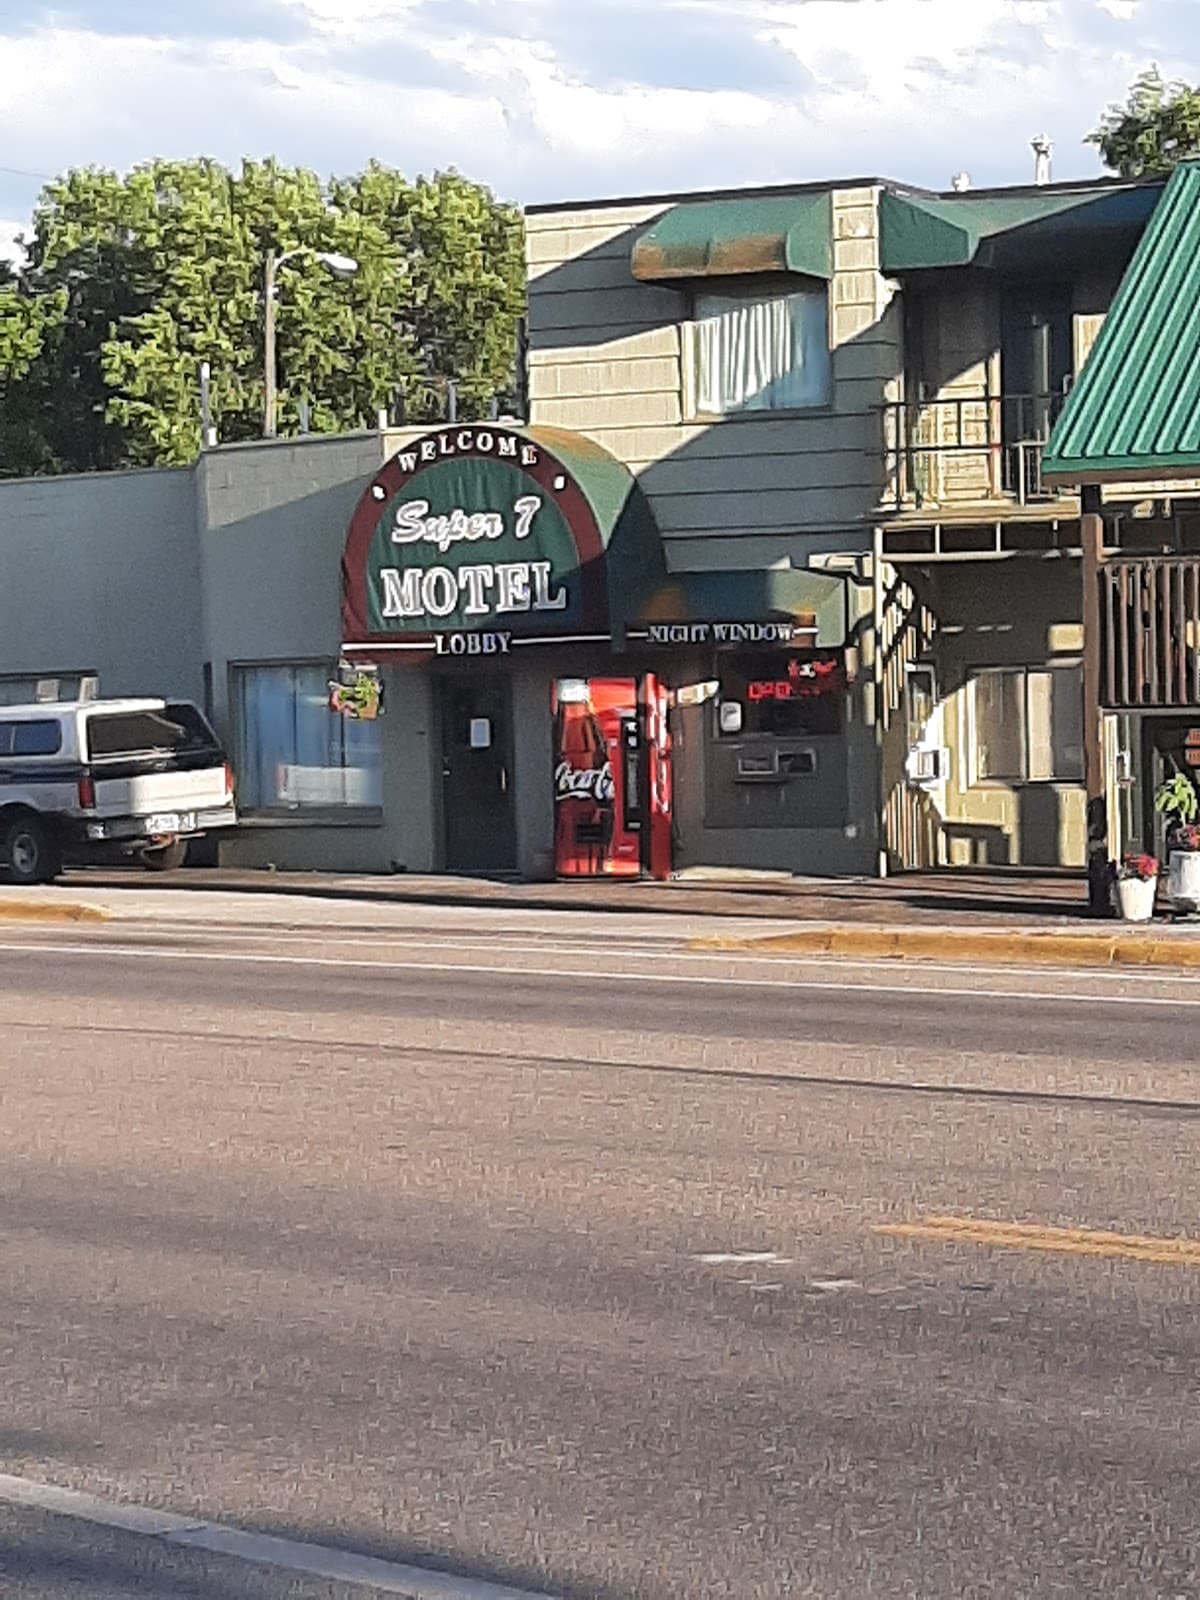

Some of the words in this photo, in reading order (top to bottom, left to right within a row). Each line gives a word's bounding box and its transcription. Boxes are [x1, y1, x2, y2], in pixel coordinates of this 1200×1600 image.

[399, 430, 538, 473] WELCOME
[391, 500, 504, 553] Super
[514, 495, 542, 539] 7
[380, 562, 567, 618] MOTEL
[435, 632, 512, 655] LOBBY
[647, 624, 709, 643] NIGHT
[713, 623, 795, 641] WINDOW
